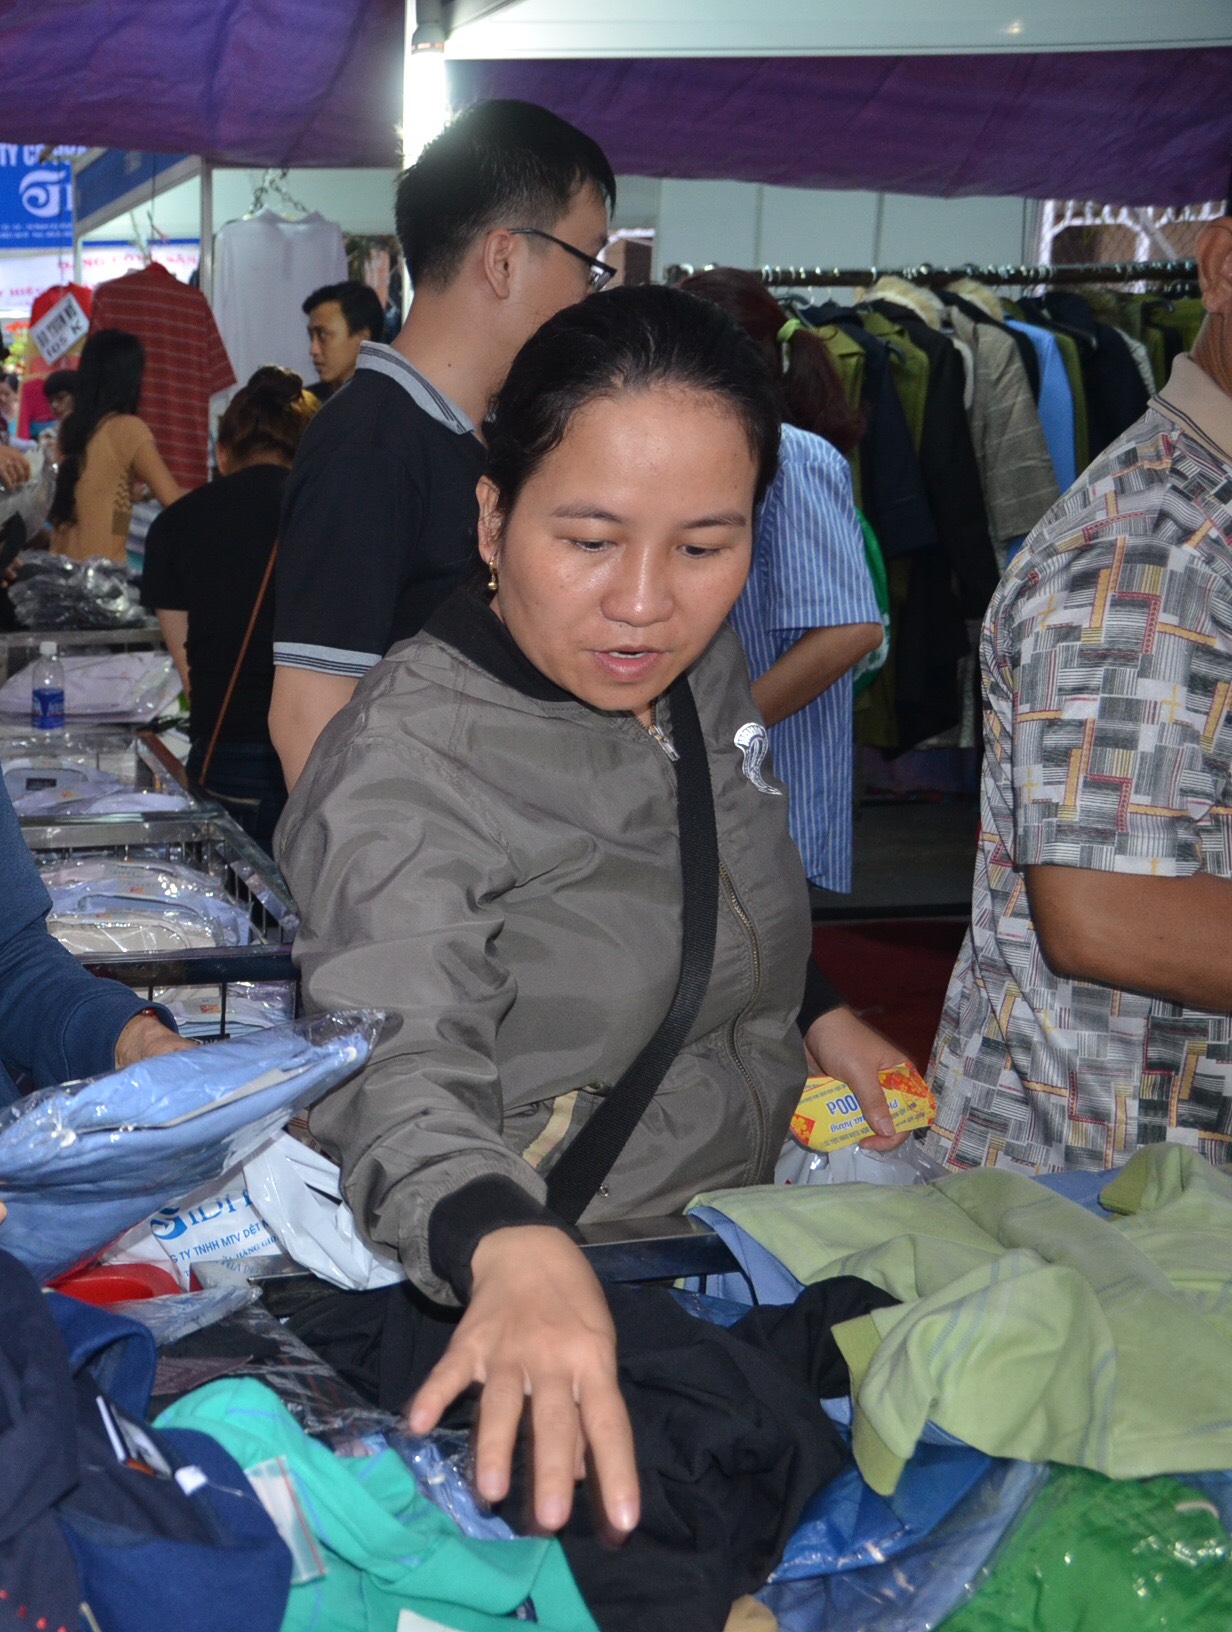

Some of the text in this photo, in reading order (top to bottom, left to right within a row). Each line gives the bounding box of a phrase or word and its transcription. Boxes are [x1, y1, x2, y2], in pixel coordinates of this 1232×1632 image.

[830, 1120, 853, 1133] hàng
[179, 1248, 191, 1261] TY
[193, 1239, 221, 1256] TNHH
[221, 1232, 242, 1247] MTV
[243, 1222, 262, 1238] DỆT
